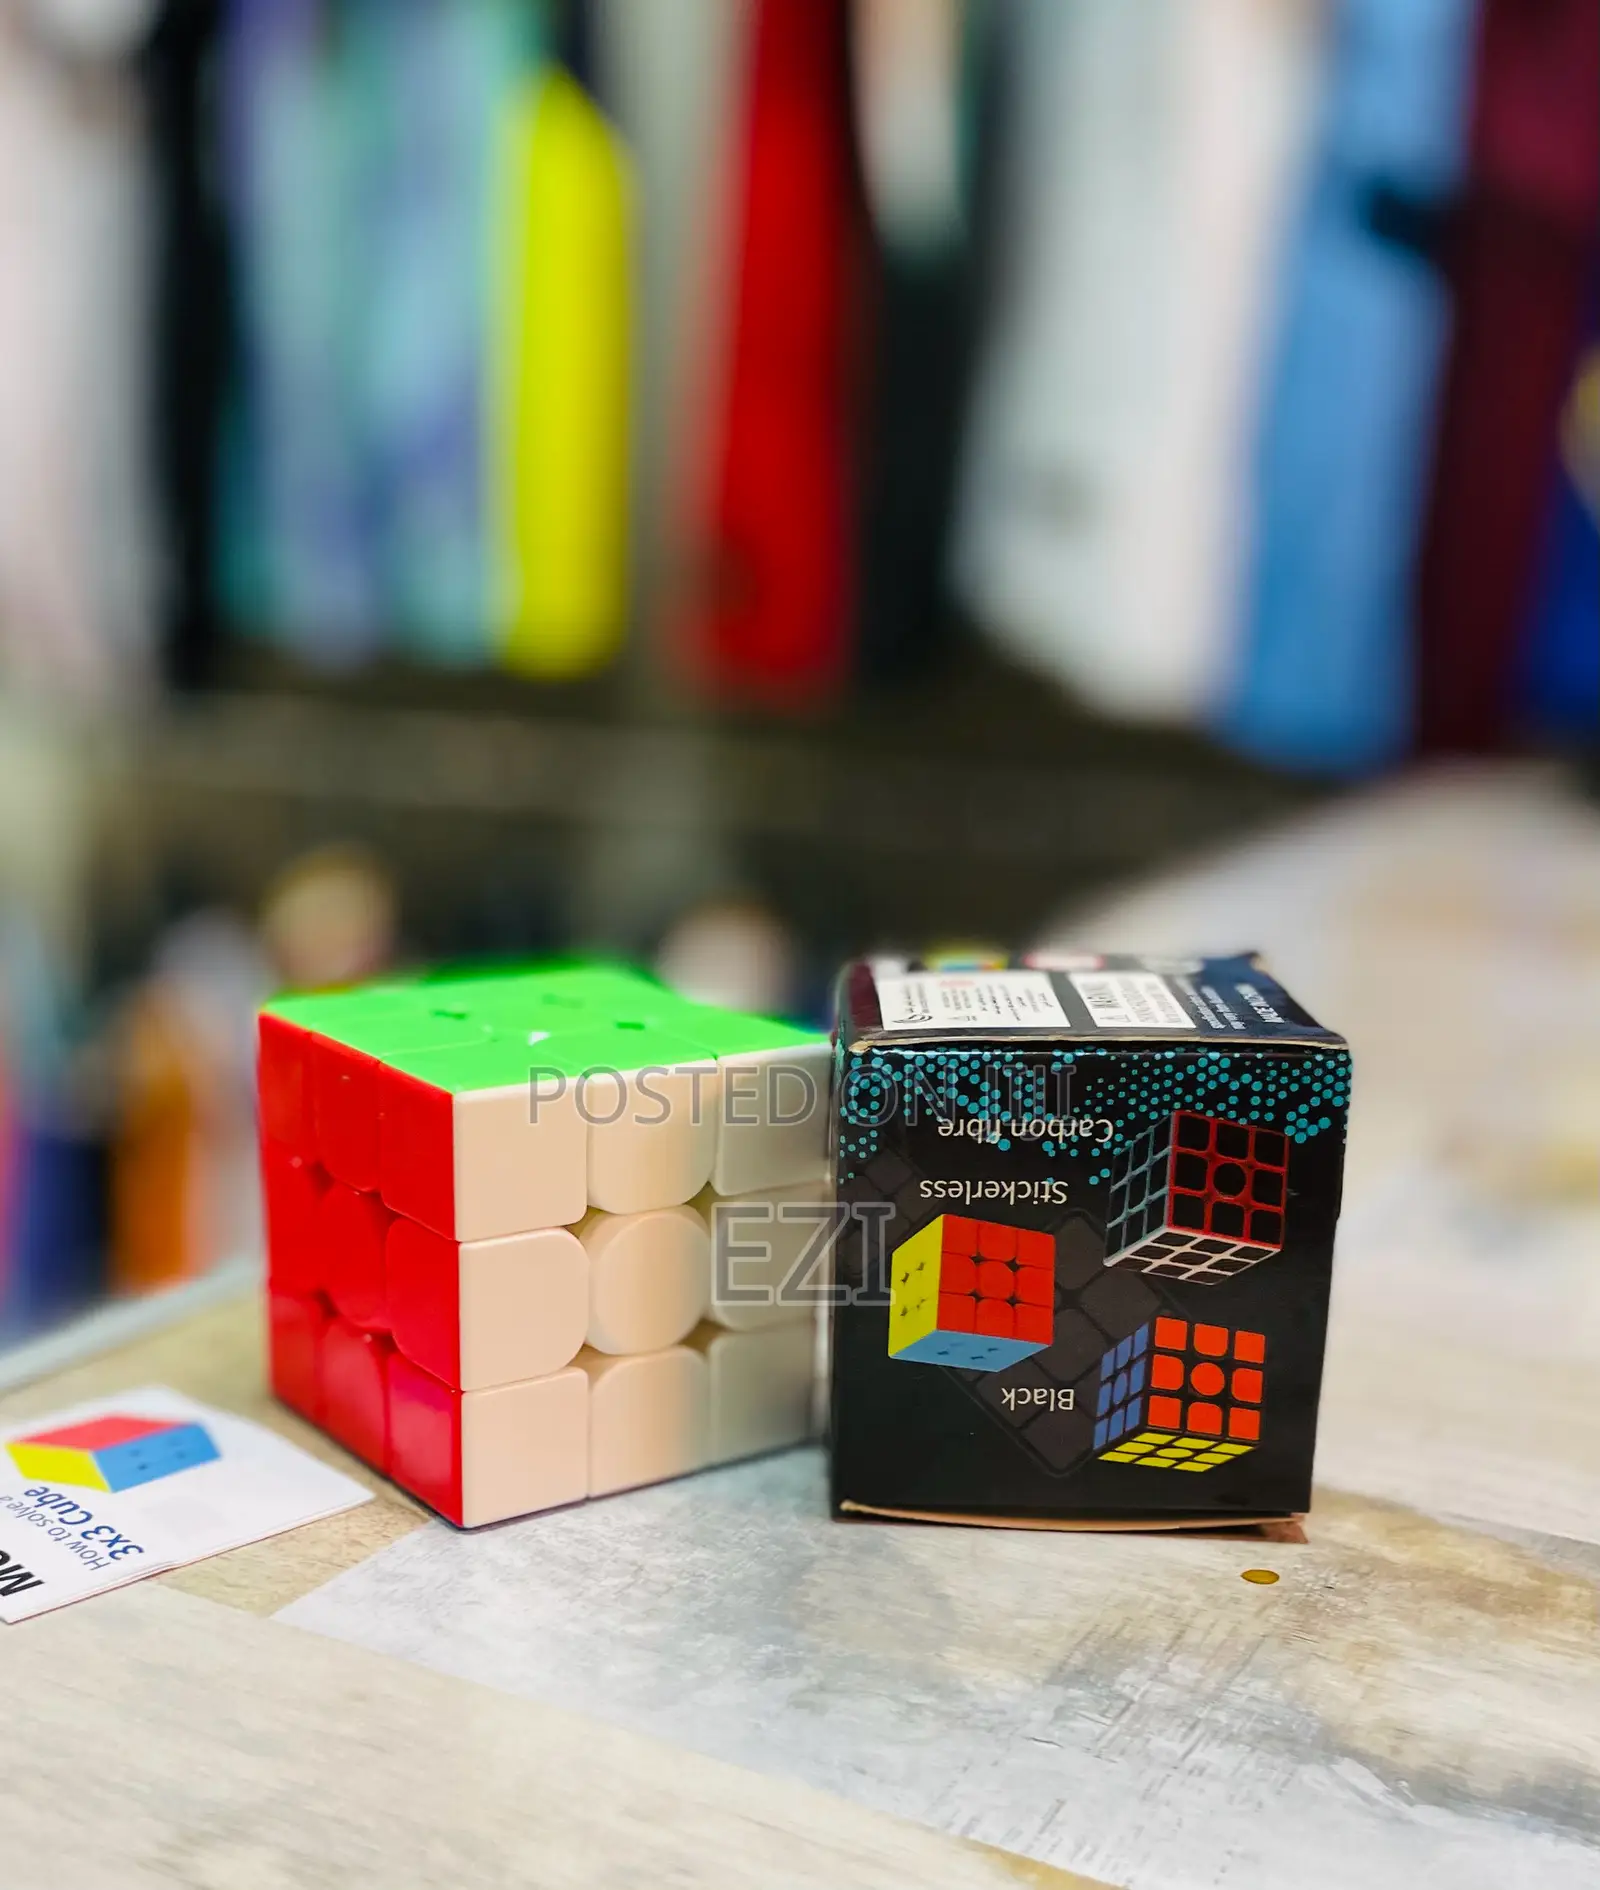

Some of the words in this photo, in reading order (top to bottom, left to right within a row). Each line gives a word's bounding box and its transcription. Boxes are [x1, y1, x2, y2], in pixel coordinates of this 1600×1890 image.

[937, 1118, 1002, 1144] fibre
[1011, 1118, 1114, 1144] Carbon
[919, 1179, 1069, 1206] Stickerless
[1001, 1387, 1075, 1412] Black
[6, 1501, 54, 1528] solve
[24, 1486, 93, 1526] Cube
[47, 1526, 72, 1542] to
[80, 1525, 144, 1561] 3x3
[65, 1540, 111, 1571] How
